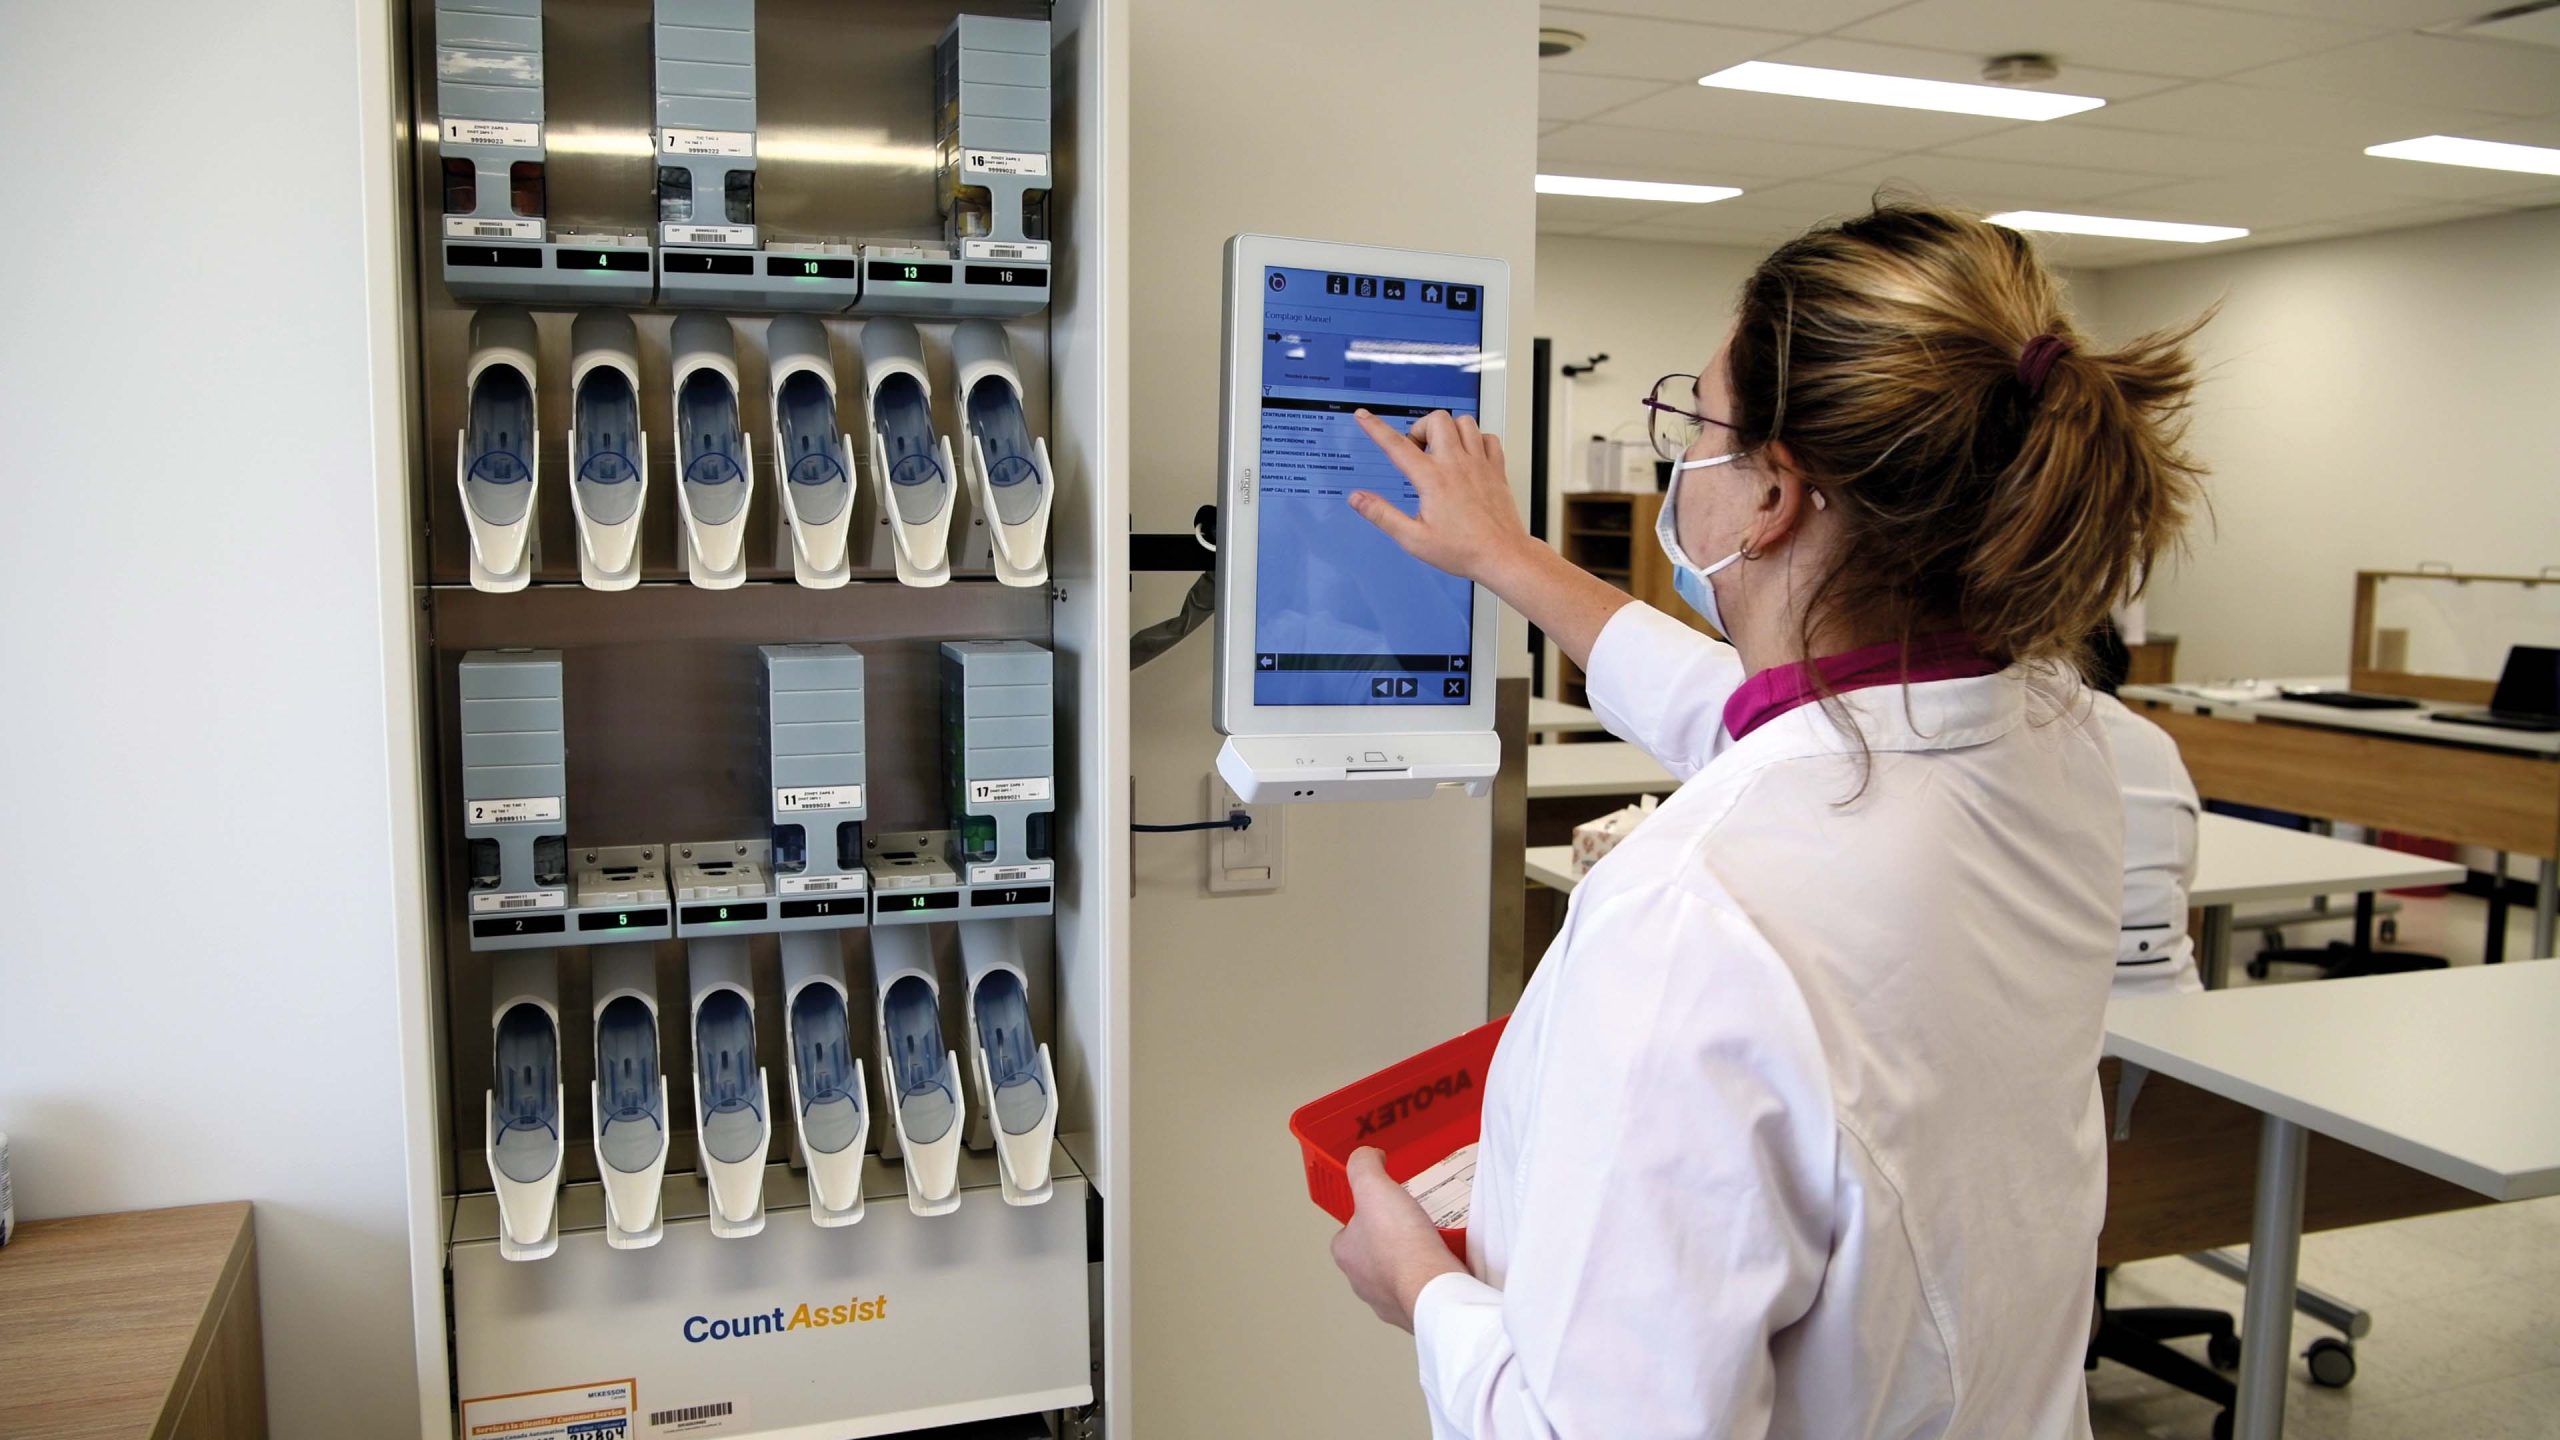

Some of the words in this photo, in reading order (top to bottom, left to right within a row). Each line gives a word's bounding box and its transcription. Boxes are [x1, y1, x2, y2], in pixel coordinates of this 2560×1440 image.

[451, 126, 457, 137] 1
[668, 136, 675, 147] 7
[972, 156, 985, 167] 16
[492, 251, 498, 263] 1
[600, 254, 607, 266] 4
[706, 258, 713, 269] 7
[804, 262, 819, 274] 10
[904, 267, 918, 279] 13
[1000, 271, 1013, 283] 16
[976, 786, 989, 798] 17
[784, 795, 796, 806] 11
[475, 807, 483, 819] 2
[1005, 891, 1018, 902] 17
[912, 897, 925, 908] 14
[719, 908, 727, 919] 8
[816, 903, 829, 914] 11
[619, 914, 628, 925] 5
[515, 921, 523, 932] 2
